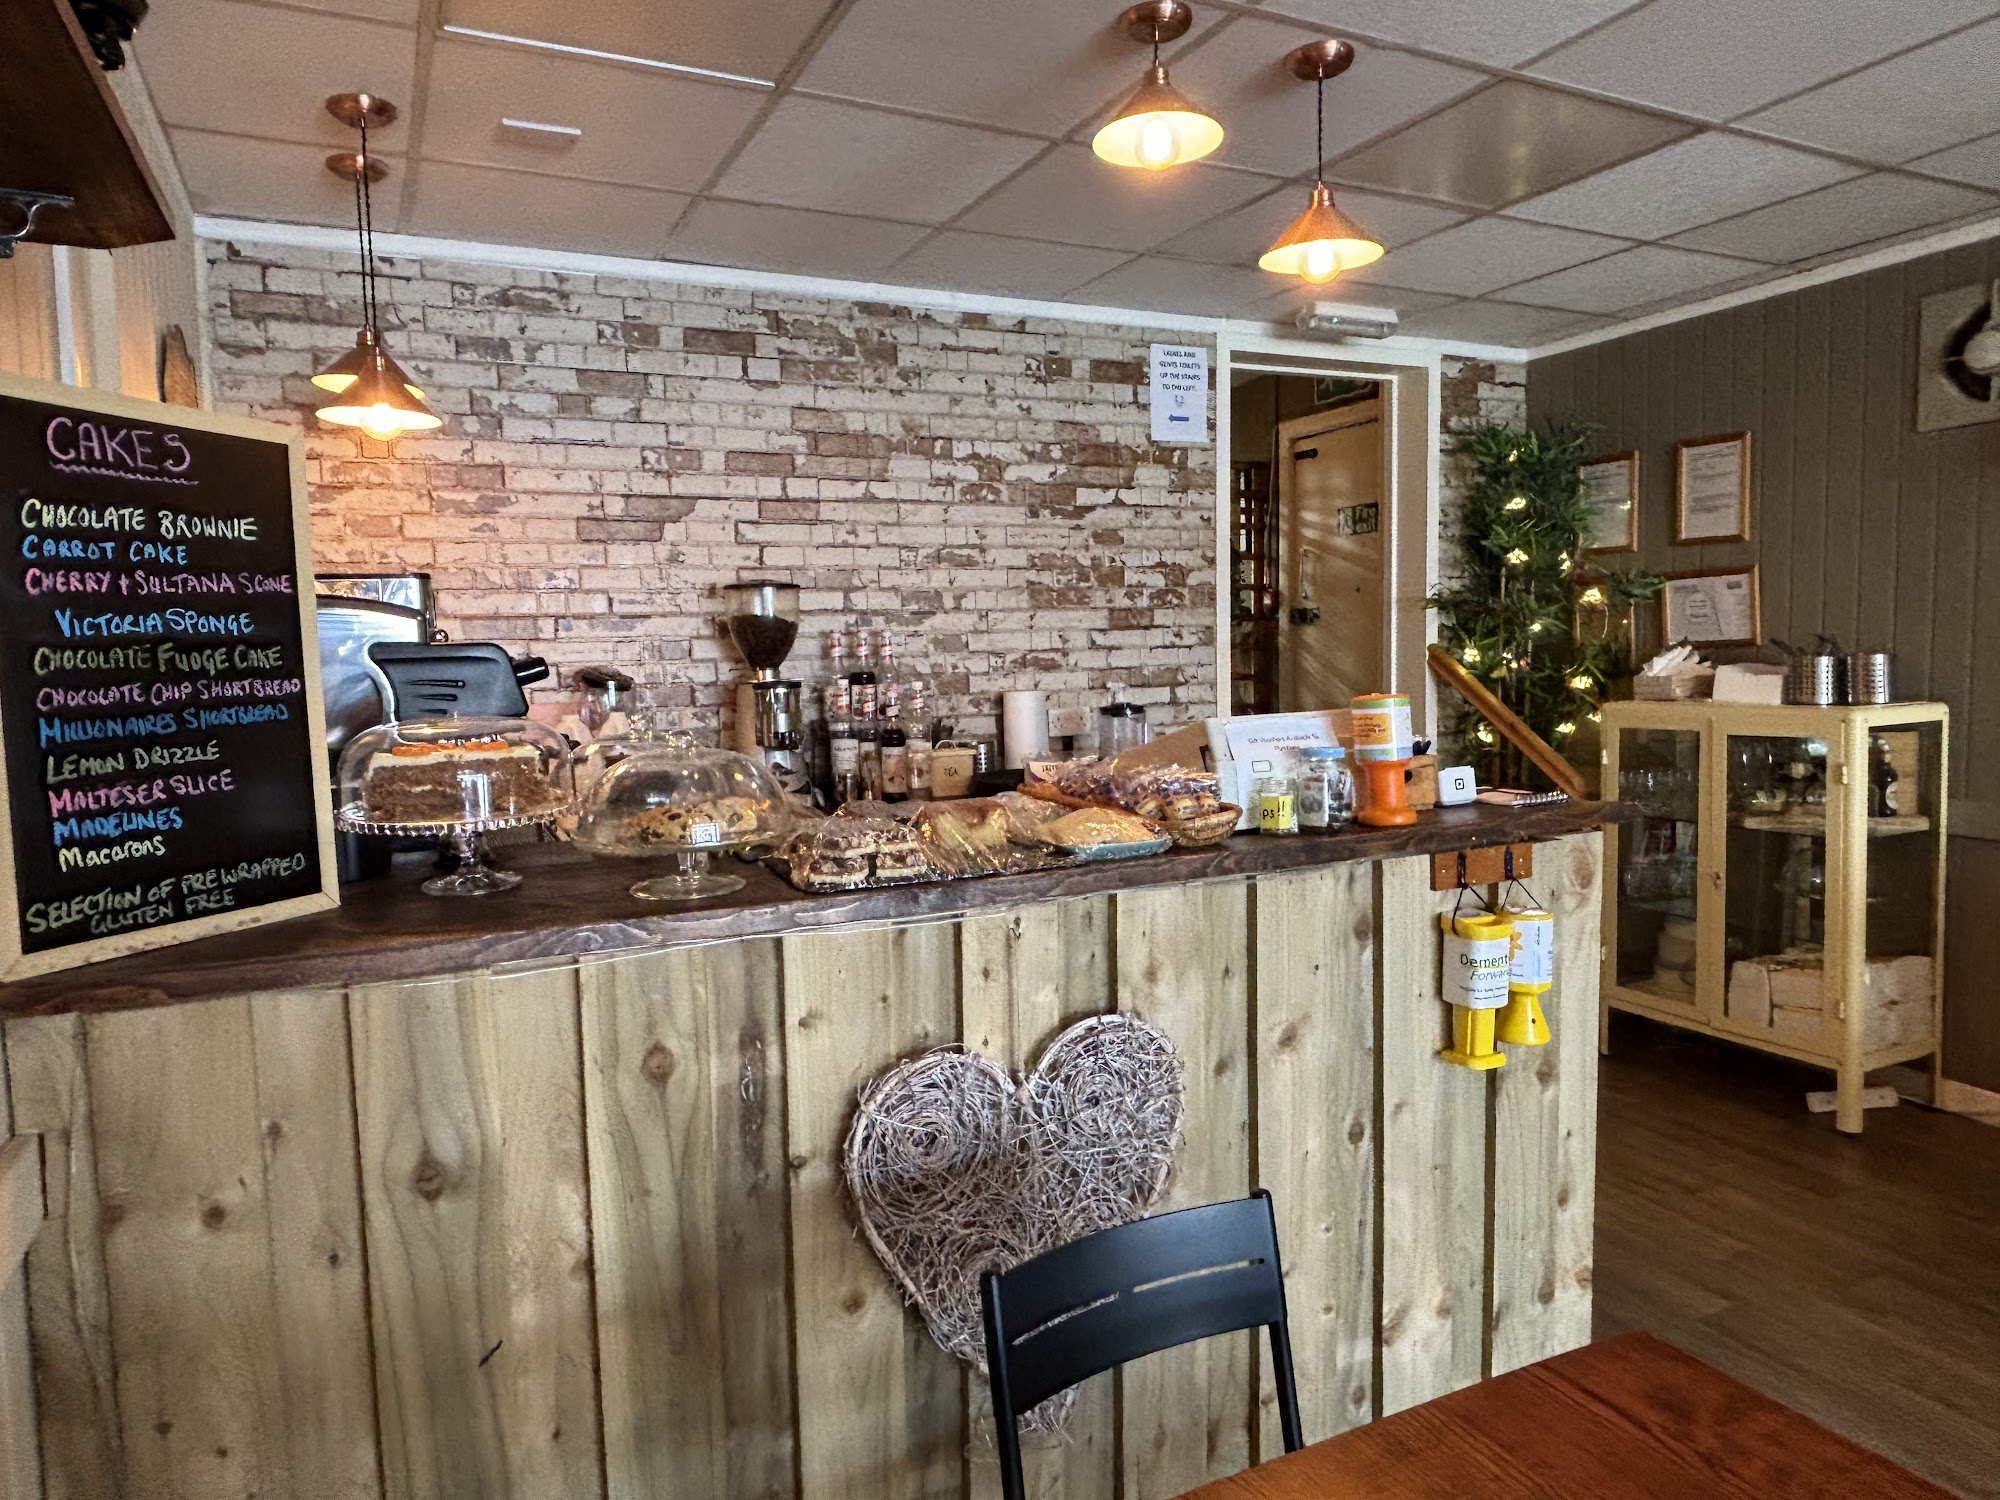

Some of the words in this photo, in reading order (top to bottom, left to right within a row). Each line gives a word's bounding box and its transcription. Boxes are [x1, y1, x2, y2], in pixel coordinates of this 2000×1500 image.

[46, 417, 191, 472] CAKES
[21, 498, 145, 531] CHOCOLATE
[158, 510, 258, 540] BROWNIE
[22, 535, 115, 560] CARROT
[130, 541, 188, 565] CAKE
[24, 567, 112, 595] CHERRY
[136, 569, 236, 594] SULTANA
[241, 573, 294, 594] SCONE
[54, 608, 164, 638] VICTORIA
[165, 608, 255, 637] SPONGE
[33, 645, 151, 676] CHOCOLATE
[156, 642, 230, 677] FUDGE
[234, 645, 283, 670] CAKE
[36, 682, 146, 711] CHOCOLATE
[151, 682, 194, 706] CHIP
[199, 678, 302, 700] SHORTBREAD
[38, 711, 177, 749] MILLIONAIRES
[182, 703, 289, 730] SHORTBREAD
[46, 752, 125, 784] LEMON
[134, 740, 220, 770] DRIZZLE
[48, 779, 167, 818] MALTESER
[168, 769, 236, 795] SLICE
[53, 806, 183, 847] MADELINES
[58, 835, 166, 873] Macarons
[25, 884, 142, 934] SELECTION
[147, 878, 176, 900] OF
[90, 901, 174, 934] GLUTEN
[185, 888, 235, 916] FREE
